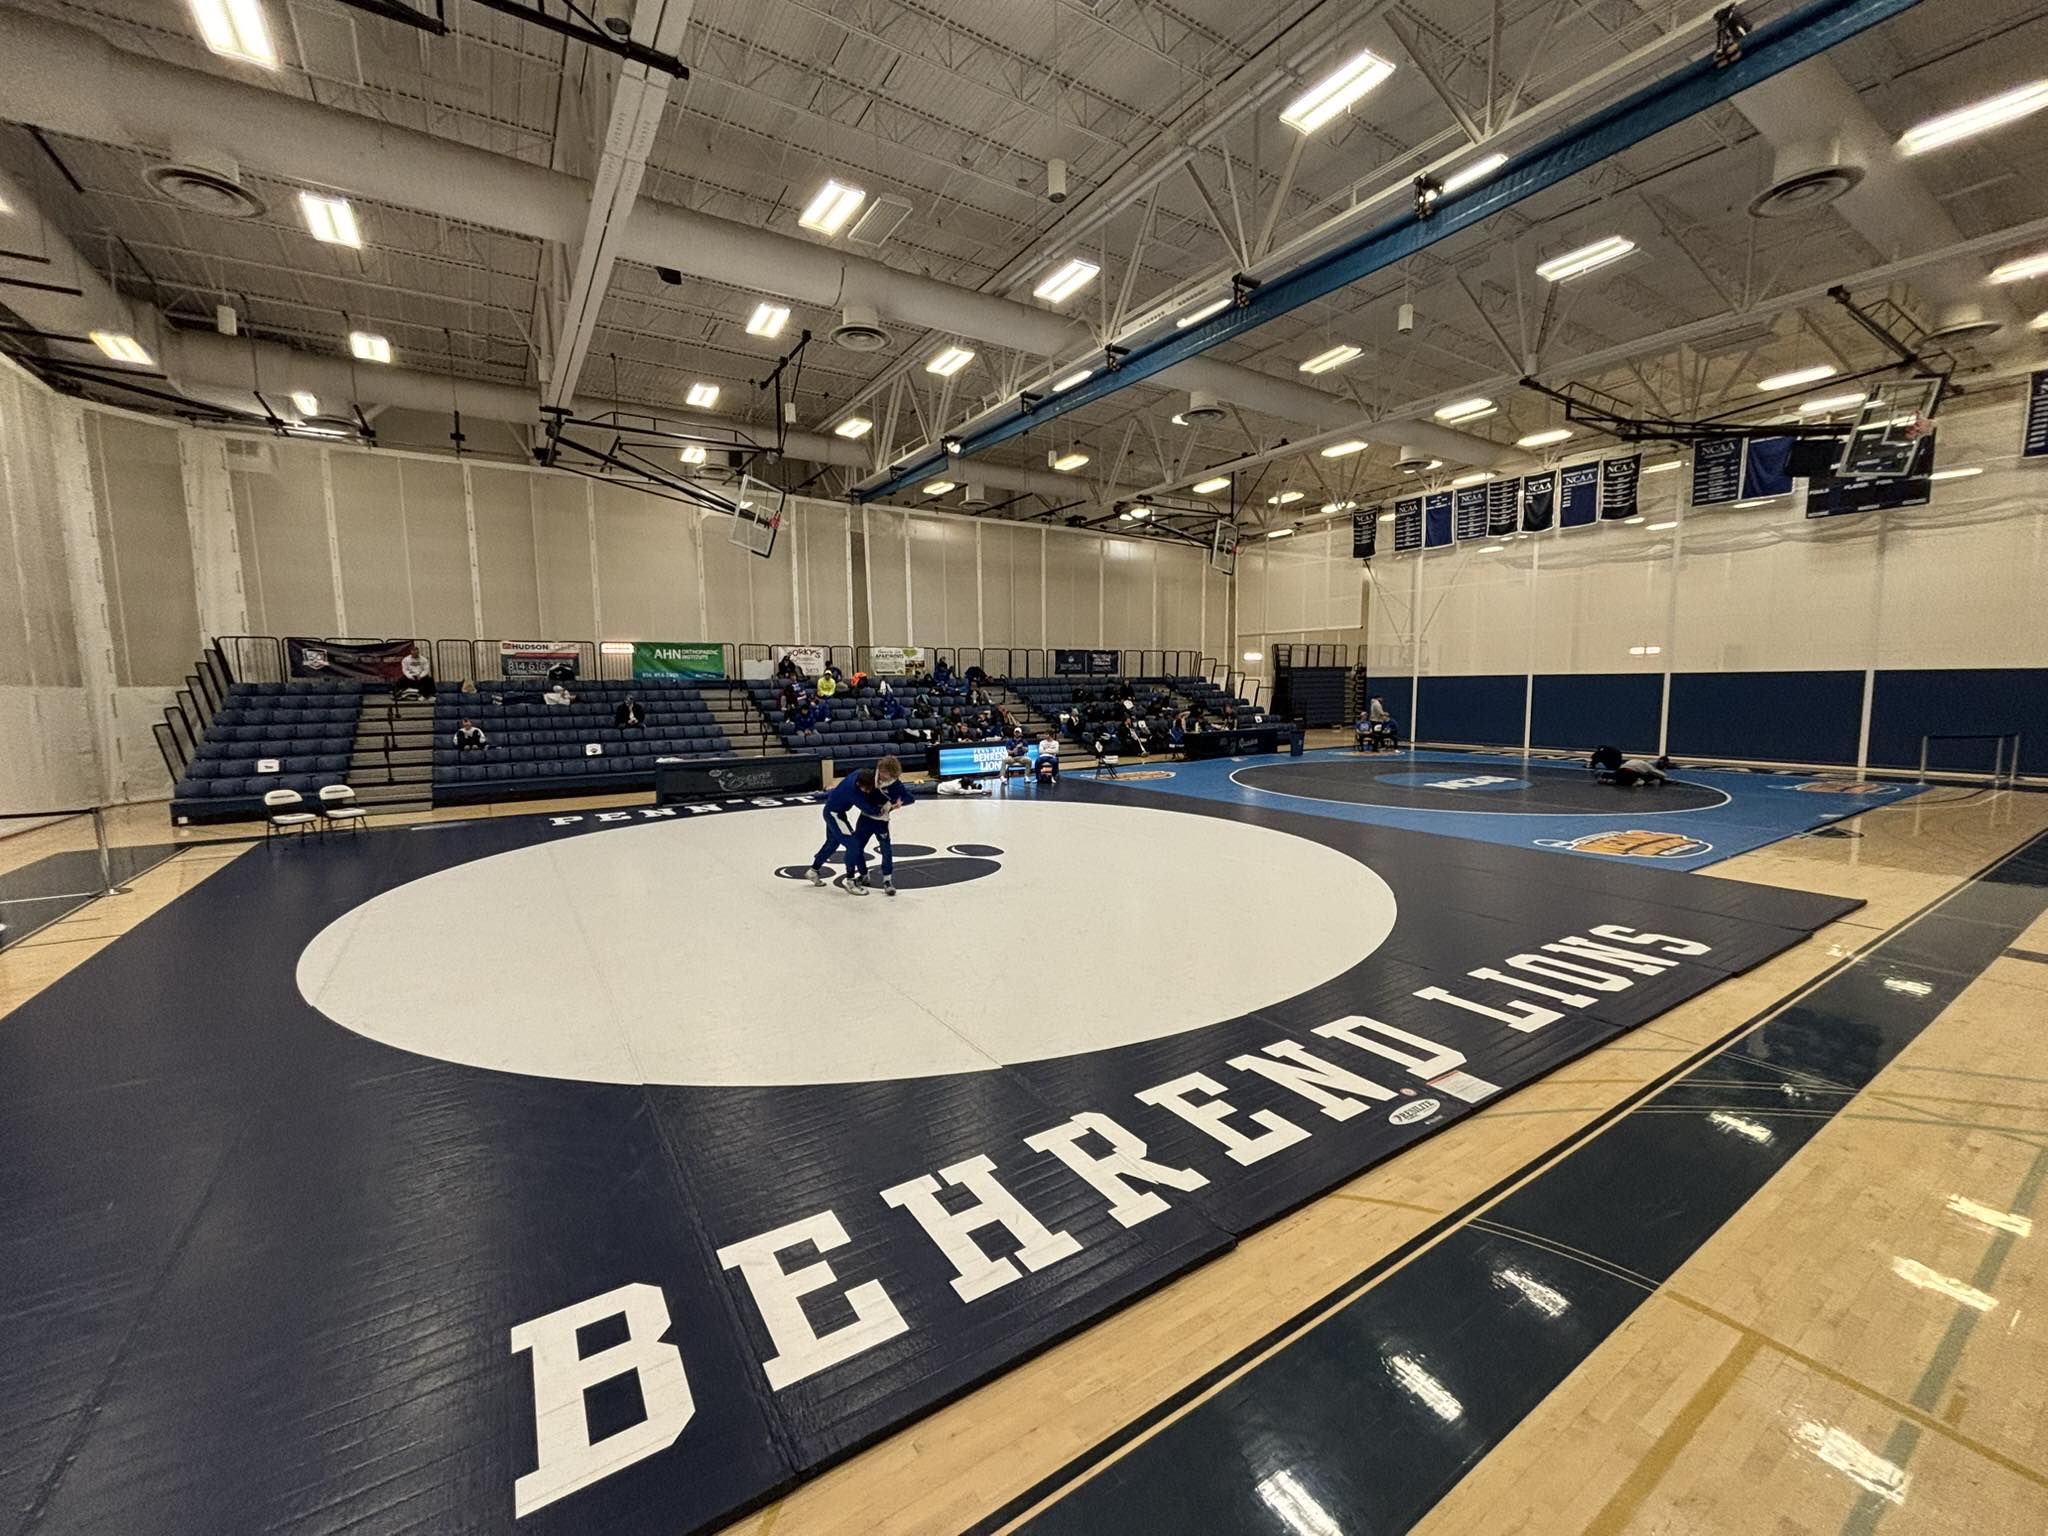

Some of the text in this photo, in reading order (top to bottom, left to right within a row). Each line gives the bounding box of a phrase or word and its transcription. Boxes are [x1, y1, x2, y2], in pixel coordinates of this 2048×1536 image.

[1702, 442, 1735, 456] NCAA
[1607, 461, 1636, 474] NCAA
[1565, 473, 1594, 485] NCAA
[1528, 482, 1552, 493] NCAA
[1461, 494, 1483, 503] NCAA
[1399, 504, 1418, 514] NCAA
[512, 643, 549, 651] HUDSON
[654, 648, 682, 660] AHN
[511, 924, 1712, 1519] BEHREND LIONS
